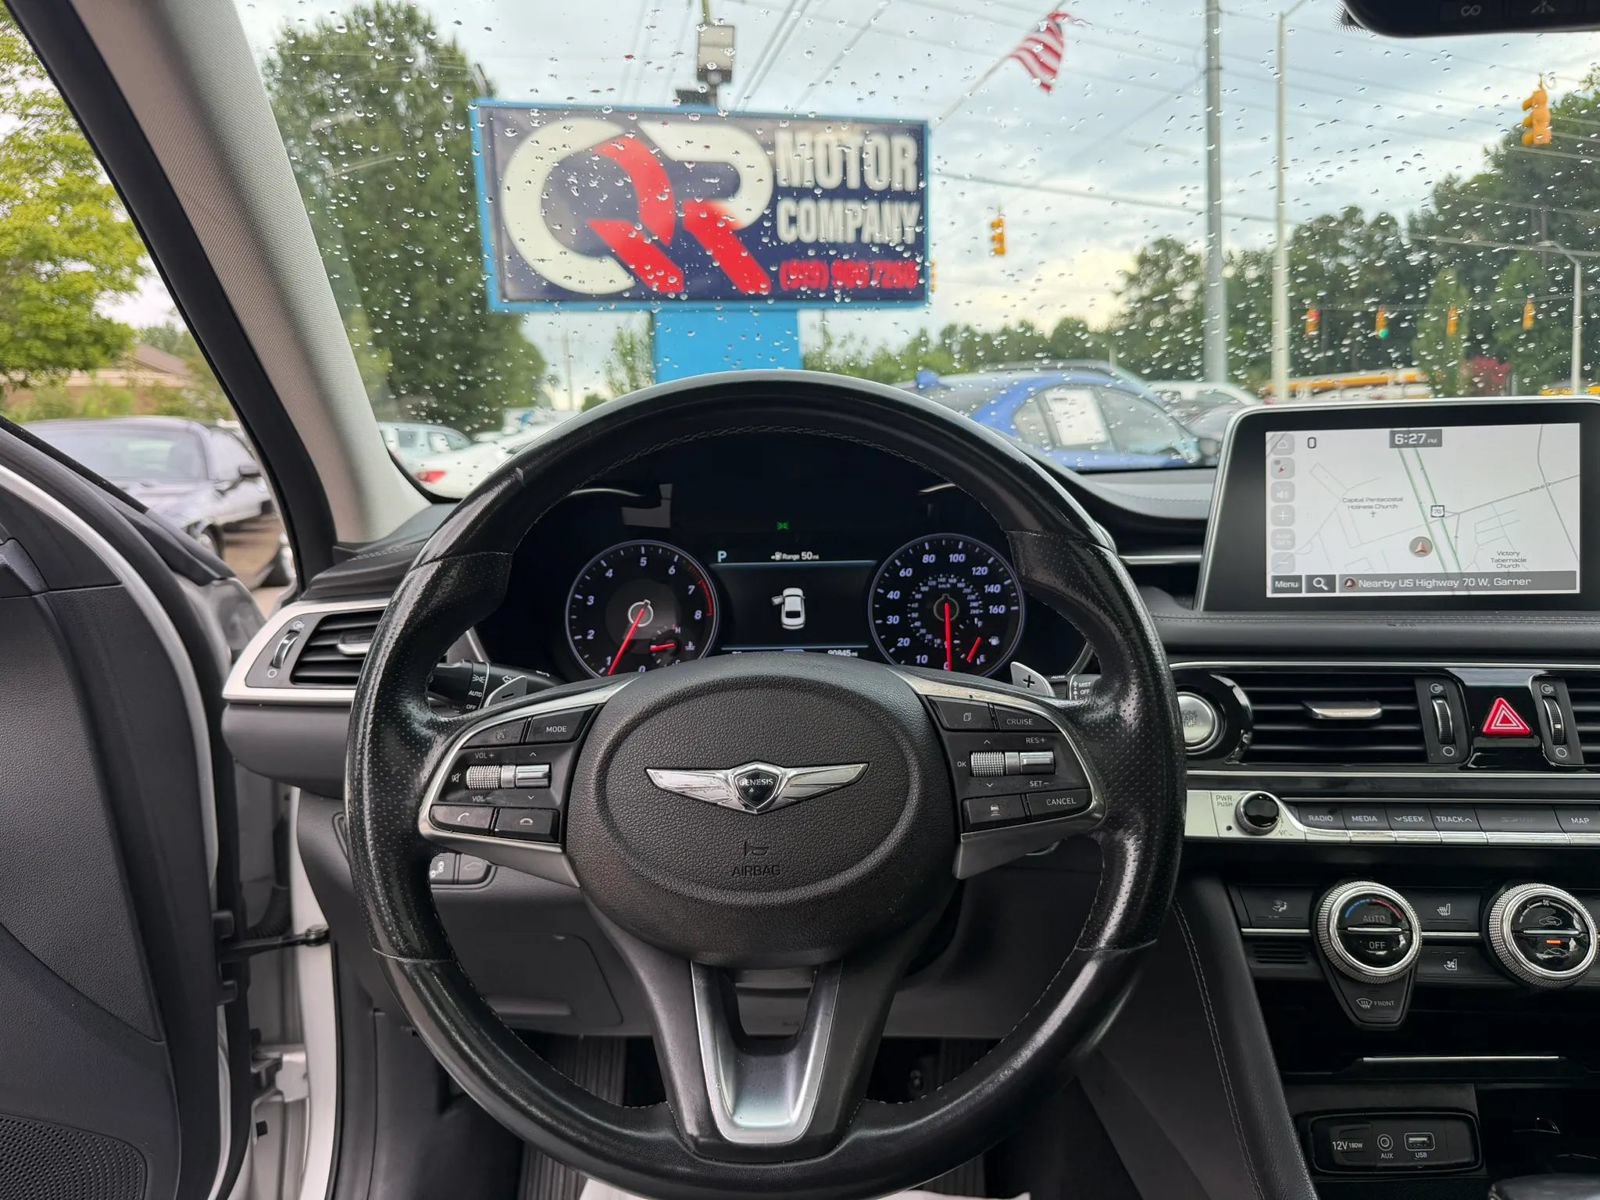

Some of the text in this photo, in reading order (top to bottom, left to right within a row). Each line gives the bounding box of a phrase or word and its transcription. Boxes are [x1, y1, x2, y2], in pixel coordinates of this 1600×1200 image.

[775, 131, 918, 192] MOTOR
[776, 198, 920, 244] COMPANY
[1395, 433, 1426, 445] 6:27
[717, 550, 727, 562] P
[922, 554, 936, 563] 80
[949, 553, 966, 563] 100
[640, 557, 647, 567] 5
[605, 569, 614, 578] 4
[668, 565, 676, 575] 6
[899, 567, 913, 577] 60
[971, 566, 989, 575] 120
[1275, 580, 1299, 588] Menu
[1358, 579, 1397, 590] Nearby
[1399, 578, 1414, 587] US
[1415, 578, 1460, 589] Highway
[1462, 577, 1476, 587] 70
[1493, 577, 1532, 586] Garner
[688, 585, 695, 595] 7
[984, 584, 1001, 593] 140
[886, 590, 901, 600] 40
[586, 595, 595, 606] 3
[988, 605, 1006, 614] 160
[694, 610, 702, 620] 8
[886, 615, 900, 625] 30
[586, 630, 595, 639] 2
[897, 637, 911, 647] 20
[606, 656, 612, 665] 1
[916, 654, 928, 664] 10
[468, 690, 483, 698] AUTO
[1006, 718, 1034, 726] CRUISE
[545, 725, 567, 733] MODE
[475, 751, 488, 759] VOL
[739, 777, 774, 787] GENESIS
[1046, 797, 1077, 806] CANCEL
[1308, 814, 1334, 822] RADIO
[1403, 815, 1425, 823] SEEK
[1436, 815, 1464, 823] TRACK
[1570, 817, 1590, 825] MAP
[731, 865, 781, 877] AIRBAG
[1363, 915, 1386, 923] AUTO
[1369, 941, 1386, 950] OFF
[1332, 1141, 1348, 1151] 12V
